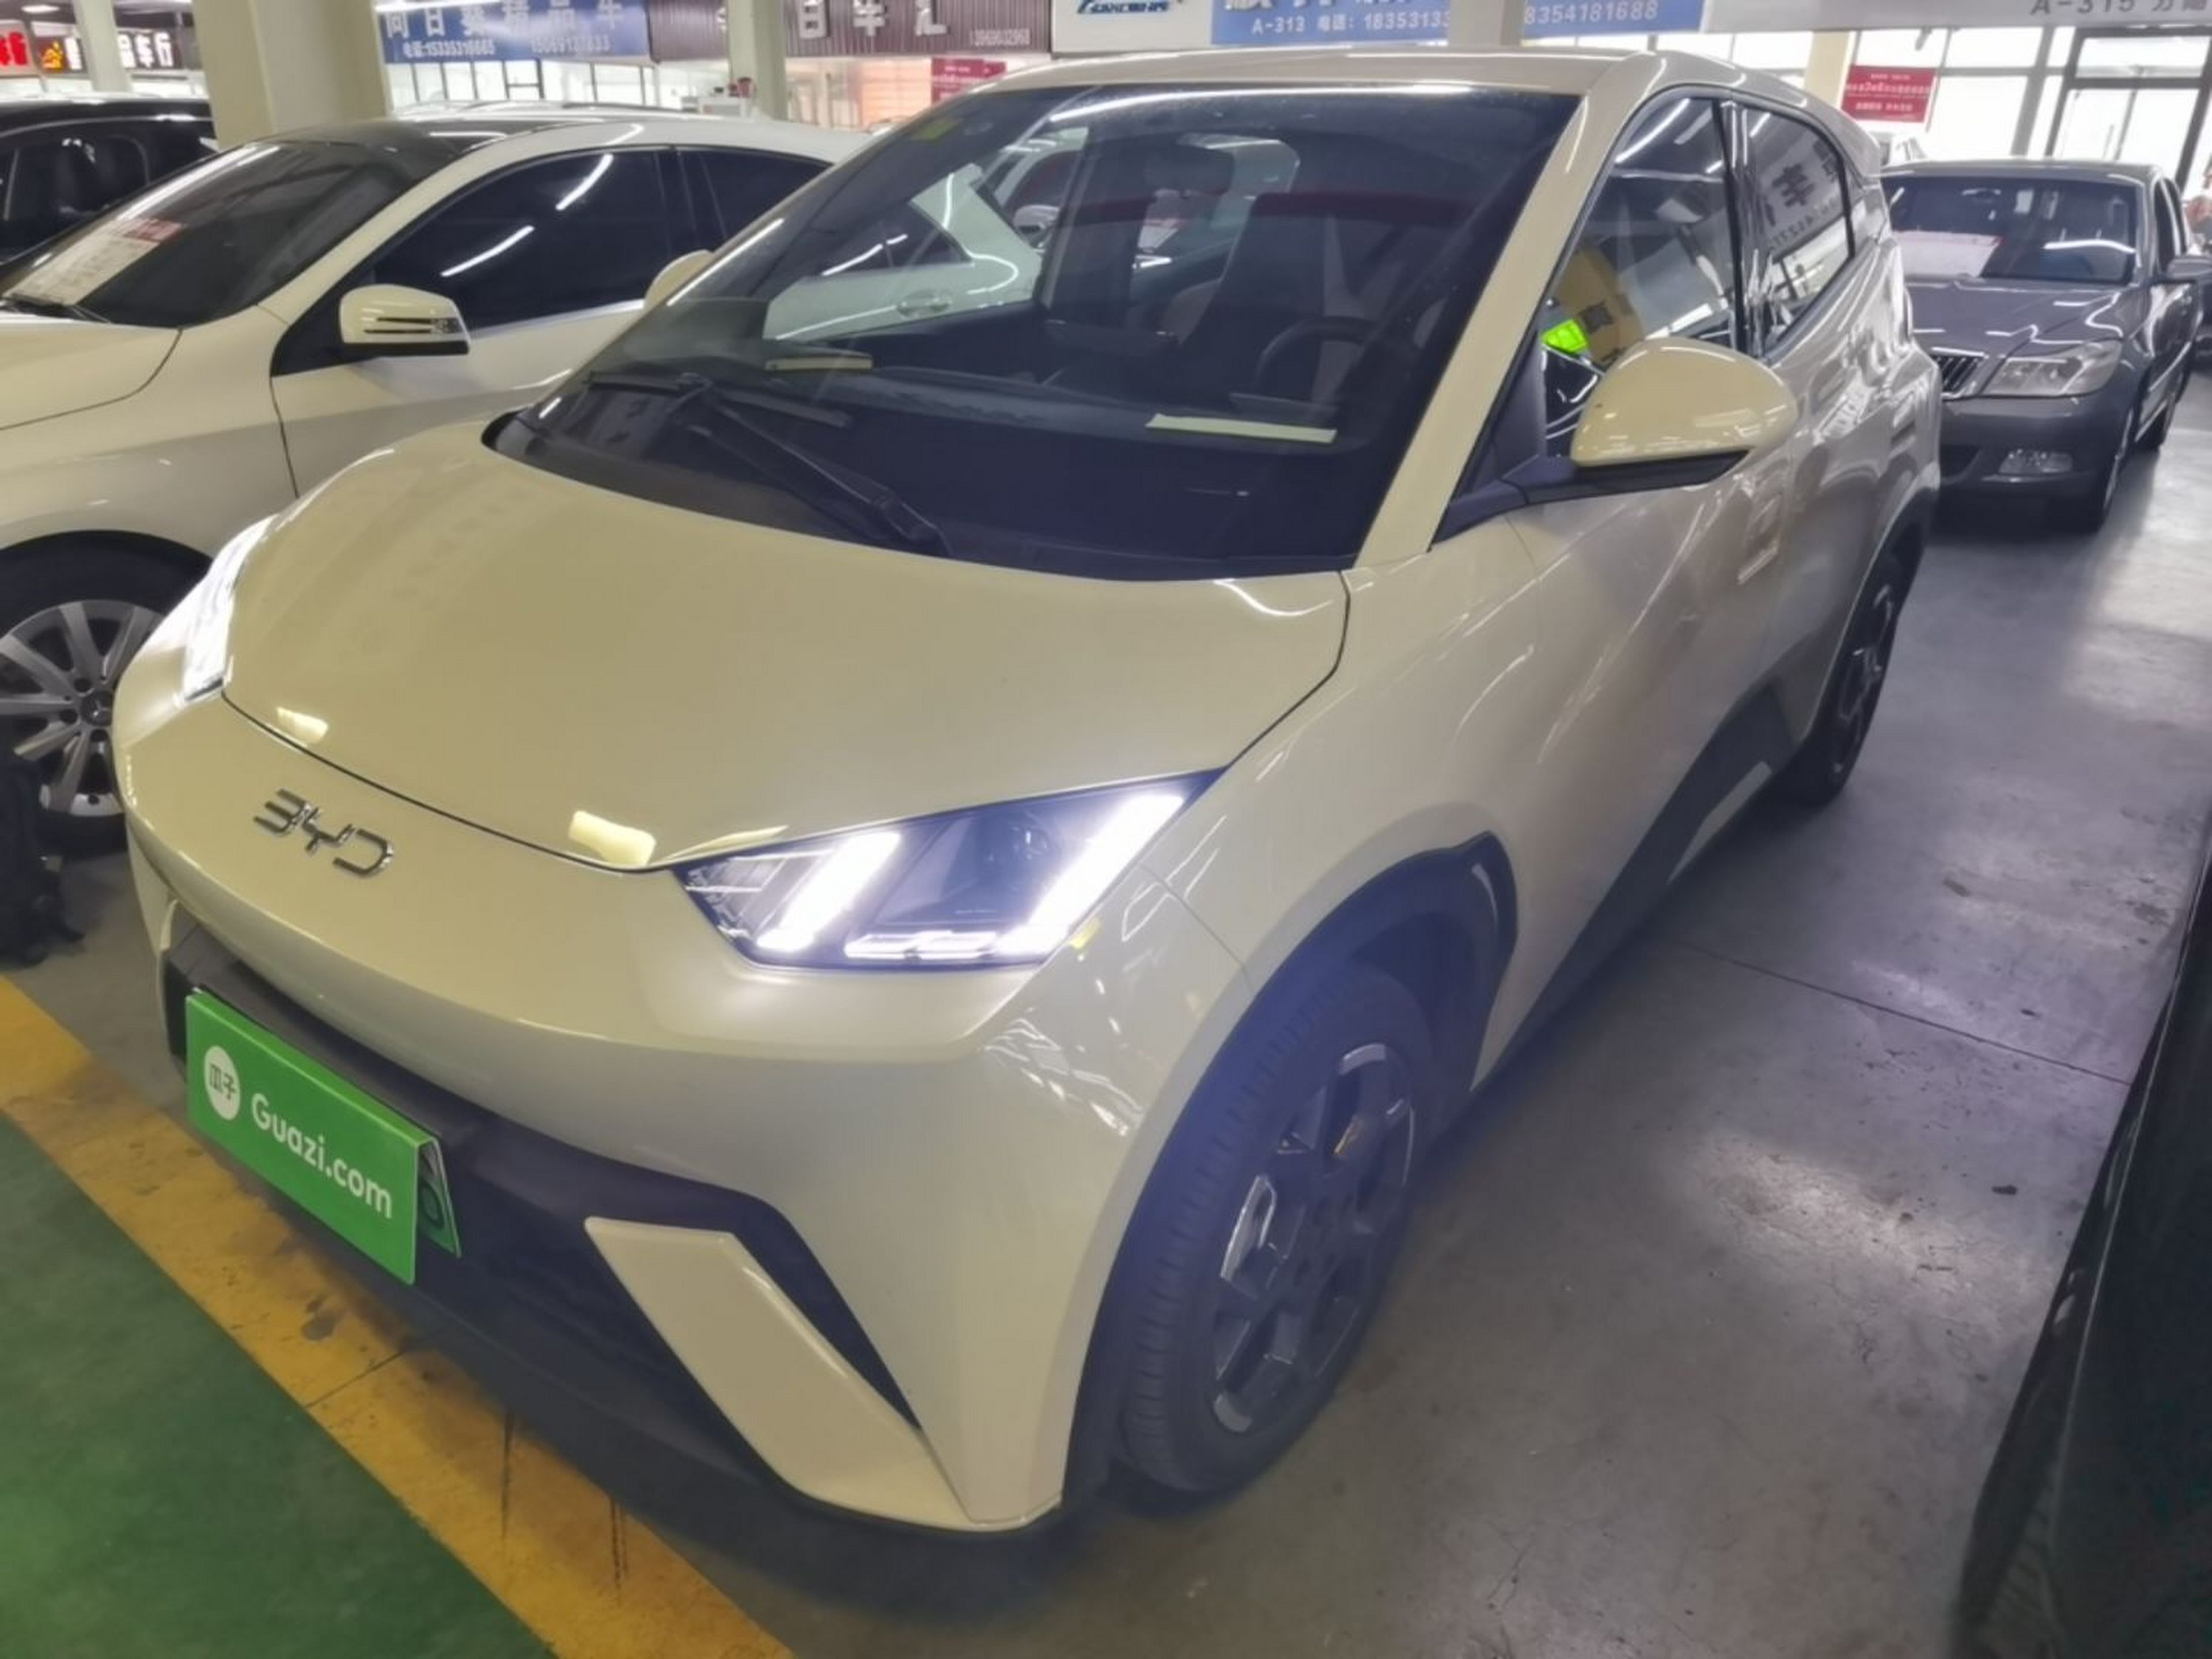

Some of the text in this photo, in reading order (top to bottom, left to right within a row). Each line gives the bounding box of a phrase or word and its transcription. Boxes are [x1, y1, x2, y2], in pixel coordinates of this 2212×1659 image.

[1252, 16, 1305, 35] A-313
[252, 788, 393, 878] BYD
[251, 1093, 393, 1219] Guazi.com
